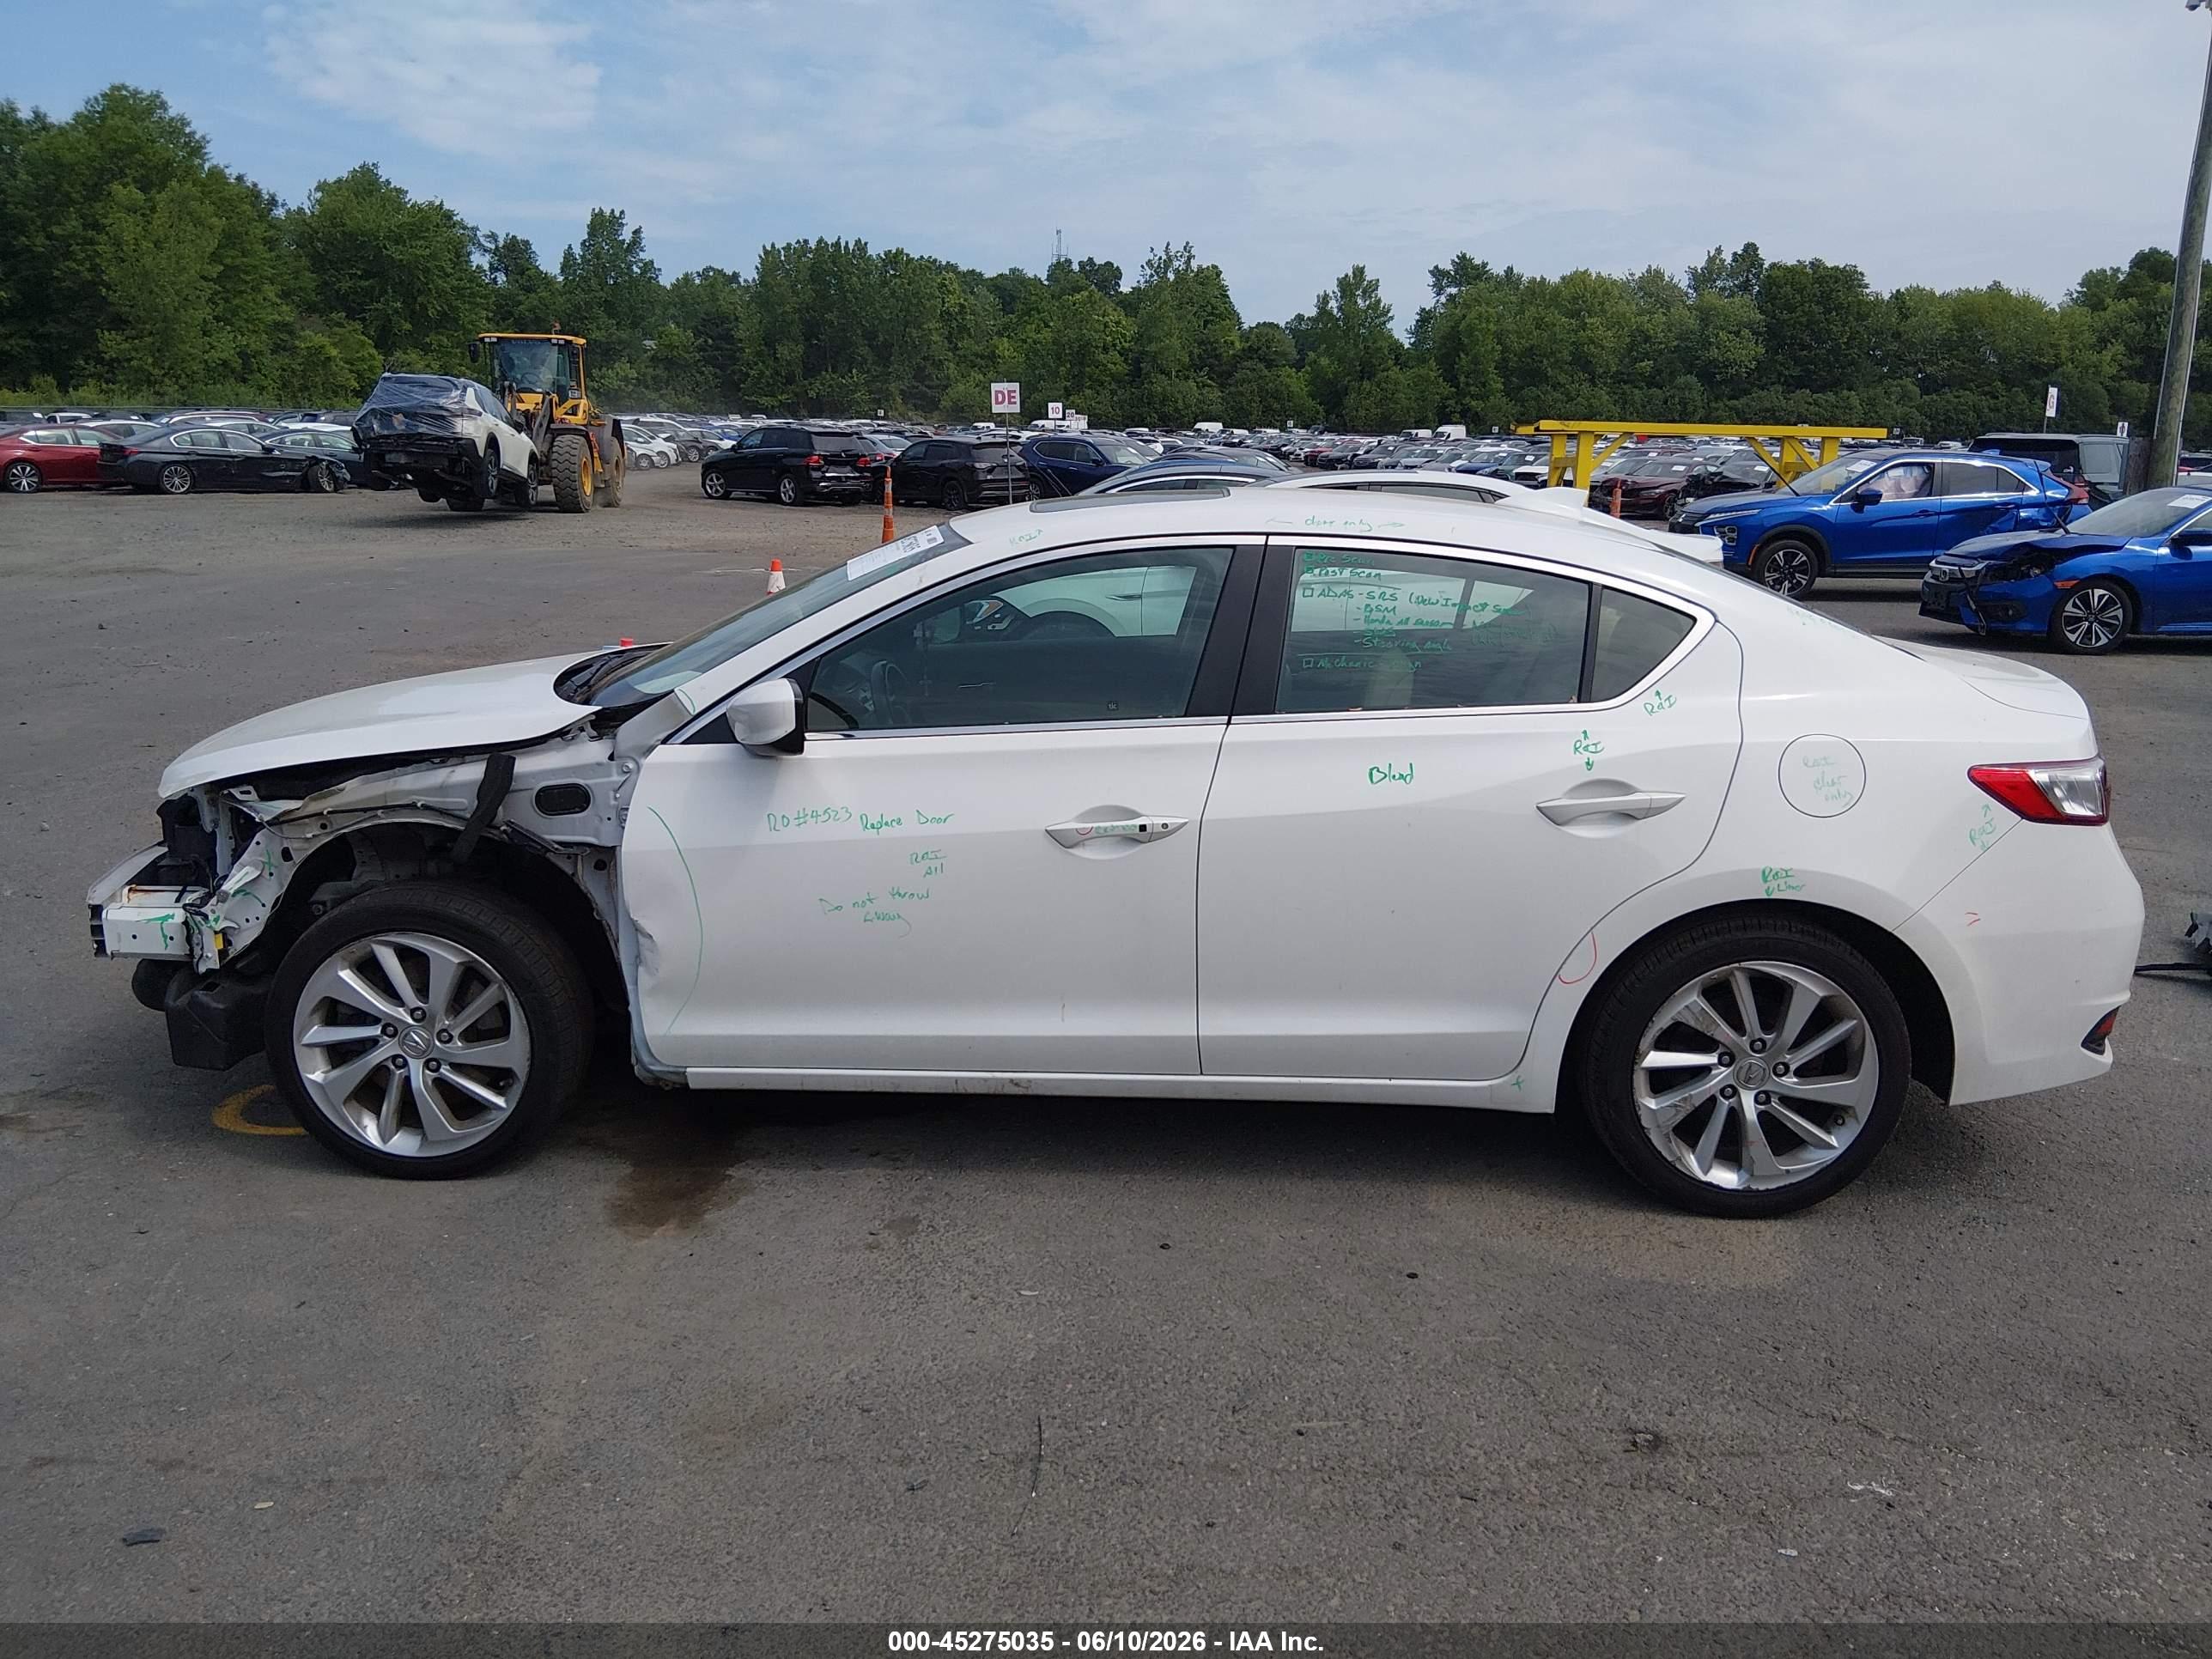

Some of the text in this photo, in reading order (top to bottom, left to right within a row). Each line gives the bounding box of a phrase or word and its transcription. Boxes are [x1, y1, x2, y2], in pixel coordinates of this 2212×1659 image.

[994, 389, 1018, 406] DE
[1050, 406, 1060, 415] 10
[1349, 568, 1382, 581] Scan
[1316, 586, 1354, 599] ADAS
[1365, 591, 1398, 601] SRS
[860, 812, 902, 836] Replace
[915, 809, 955, 824] Door
[818, 886, 929, 915] Do not throw
